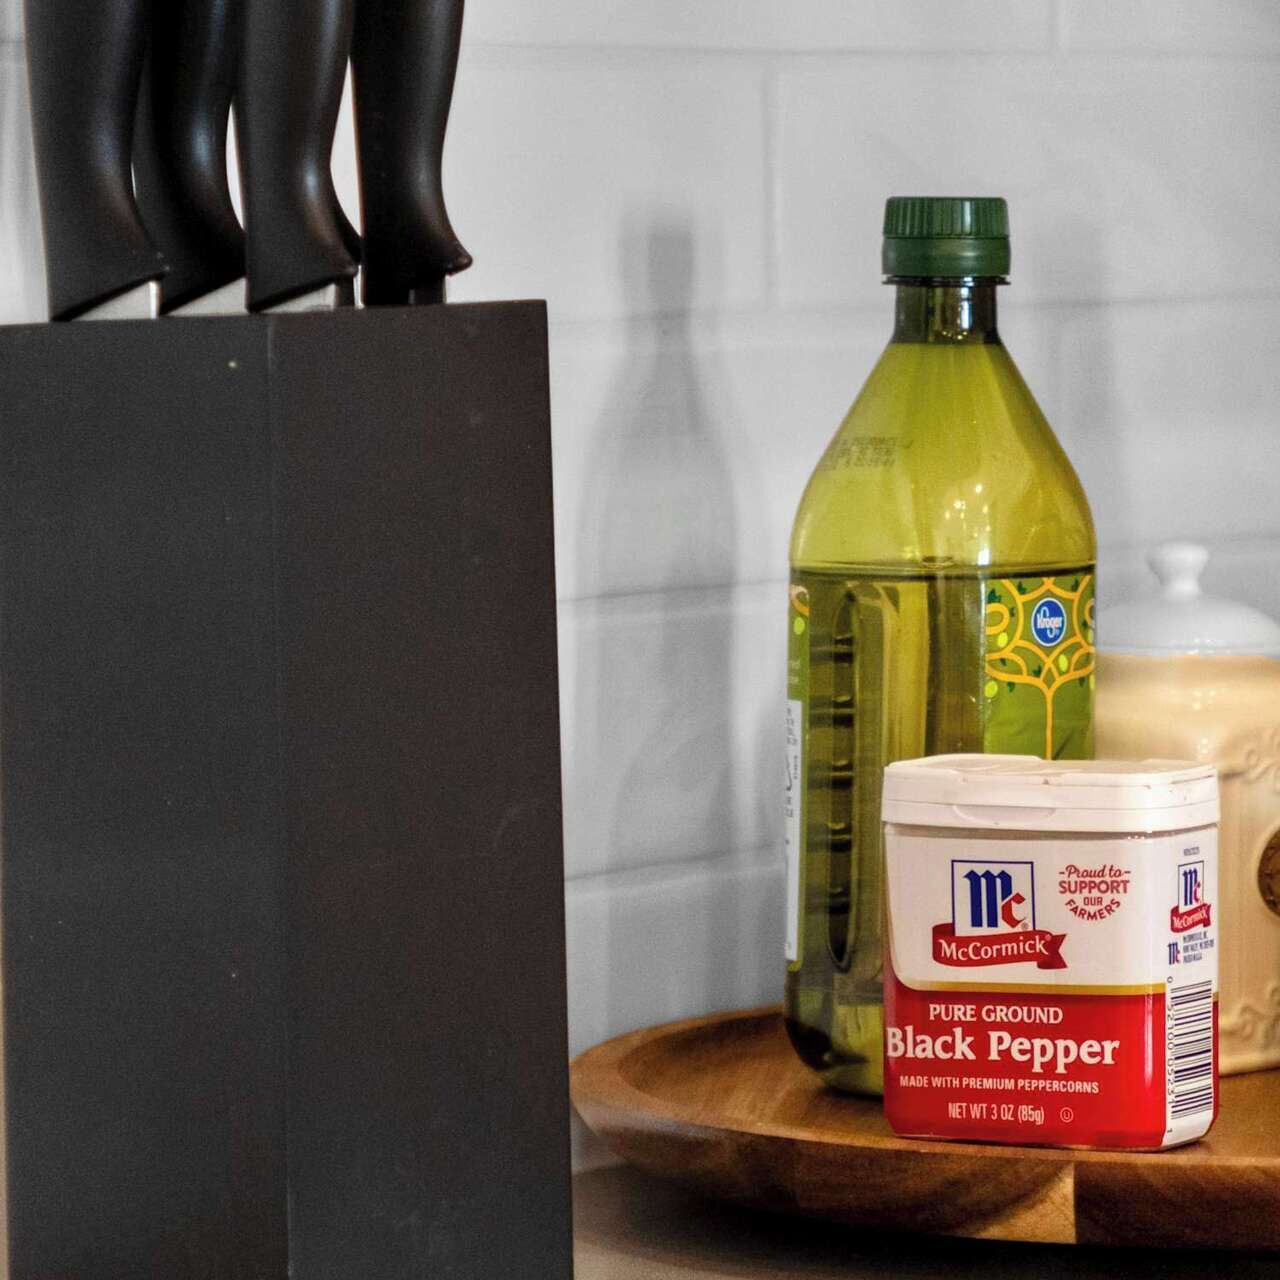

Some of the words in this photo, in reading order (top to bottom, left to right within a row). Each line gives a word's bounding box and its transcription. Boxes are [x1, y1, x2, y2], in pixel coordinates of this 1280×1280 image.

[1058, 879, 1131, 894] SUPPORT
[1065, 898, 1122, 921] FARMERS
[1083, 896, 1104, 906] OUR
[938, 934, 1050, 961] McCormick
[929, 1003, 977, 1021] PURE
[981, 1006, 1064, 1024] GROUND
[886, 1025, 976, 1060] Black
[988, 1030, 1121, 1074] Pepper
[900, 1075, 929, 1088] MADE
[931, 1076, 960, 1089] WITH
[962, 1077, 1015, 1091] PREMIUM
[1017, 1079, 1100, 1094] PEPPERCORNS
[948, 1102, 968, 1120] NET
[969, 1103, 988, 1120] WT
[991, 1104, 999, 1120] 3
[1000, 1104, 1016, 1121] OZ
[1017, 1104, 1046, 1125] (85g)
